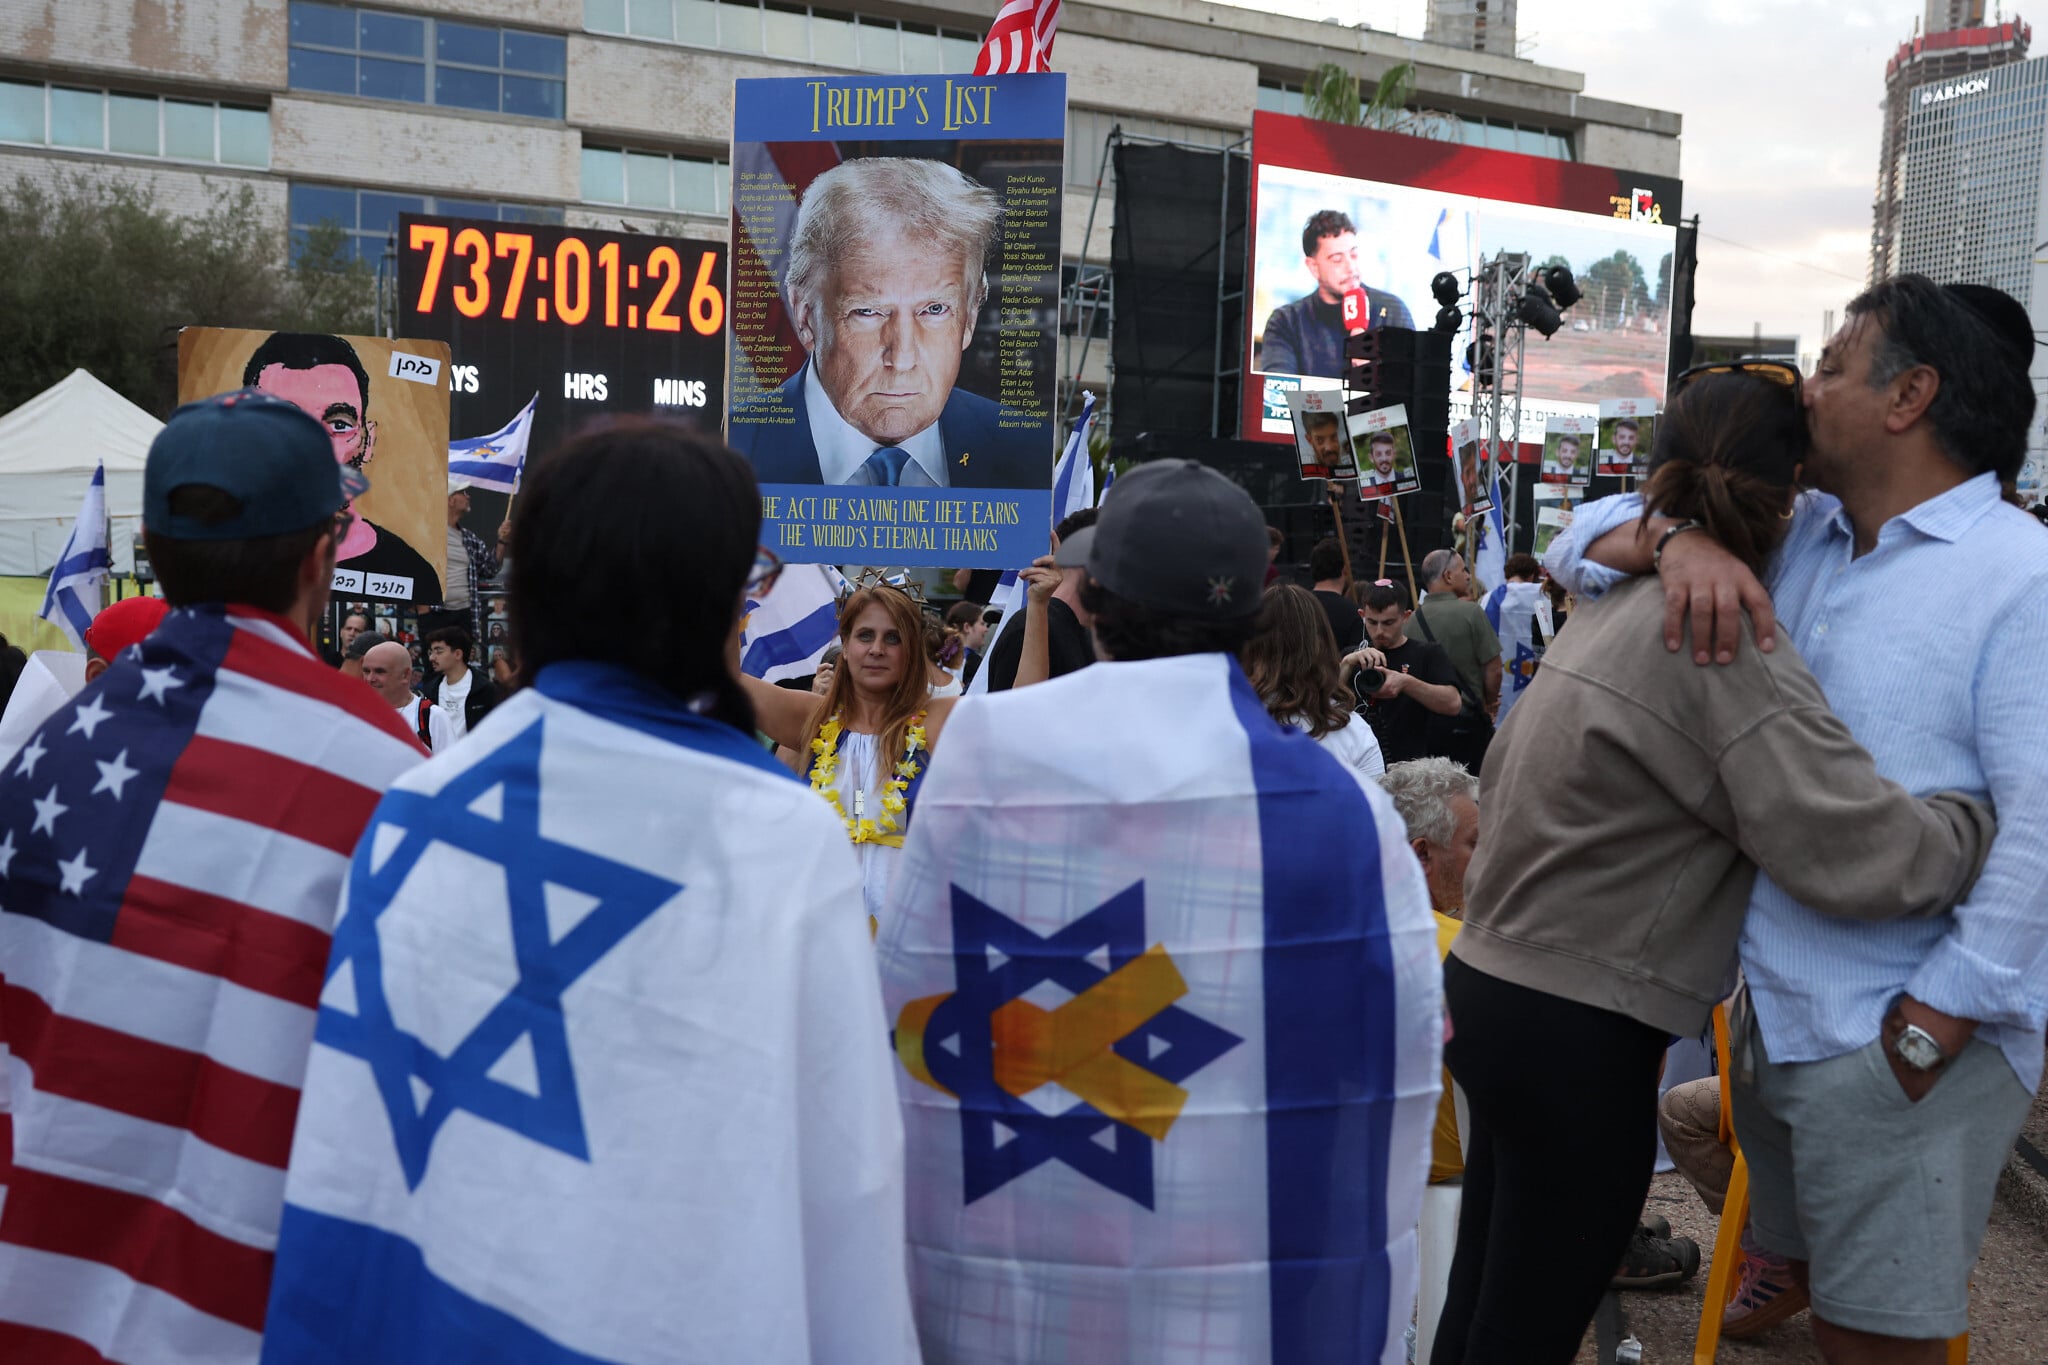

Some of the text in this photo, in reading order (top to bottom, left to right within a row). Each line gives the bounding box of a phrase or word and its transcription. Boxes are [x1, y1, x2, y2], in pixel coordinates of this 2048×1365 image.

[1933, 77, 1990, 103] ARNON
[1005, 231, 1017, 240] Guy
[1002, 264, 1024, 272] Manny
[410, 224, 724, 336] 737:01:26
[397, 358, 432, 375] מתן
[564, 372, 608, 401] HRS
[654, 378, 706, 407] MINS
[1018, 380, 1033, 388] Levy
[1022, 399, 1040, 407] Engel
[1025, 410, 1048, 418] Cooper
[762, 496, 1019, 524] HE ACT OF SAVING ONE LIFE EARNS
[778, 523, 806, 546] THE
[873, 527, 938, 550] ETERNAL
[942, 528, 997, 551] THANKS
[372, 582, 405, 594] חוזר
